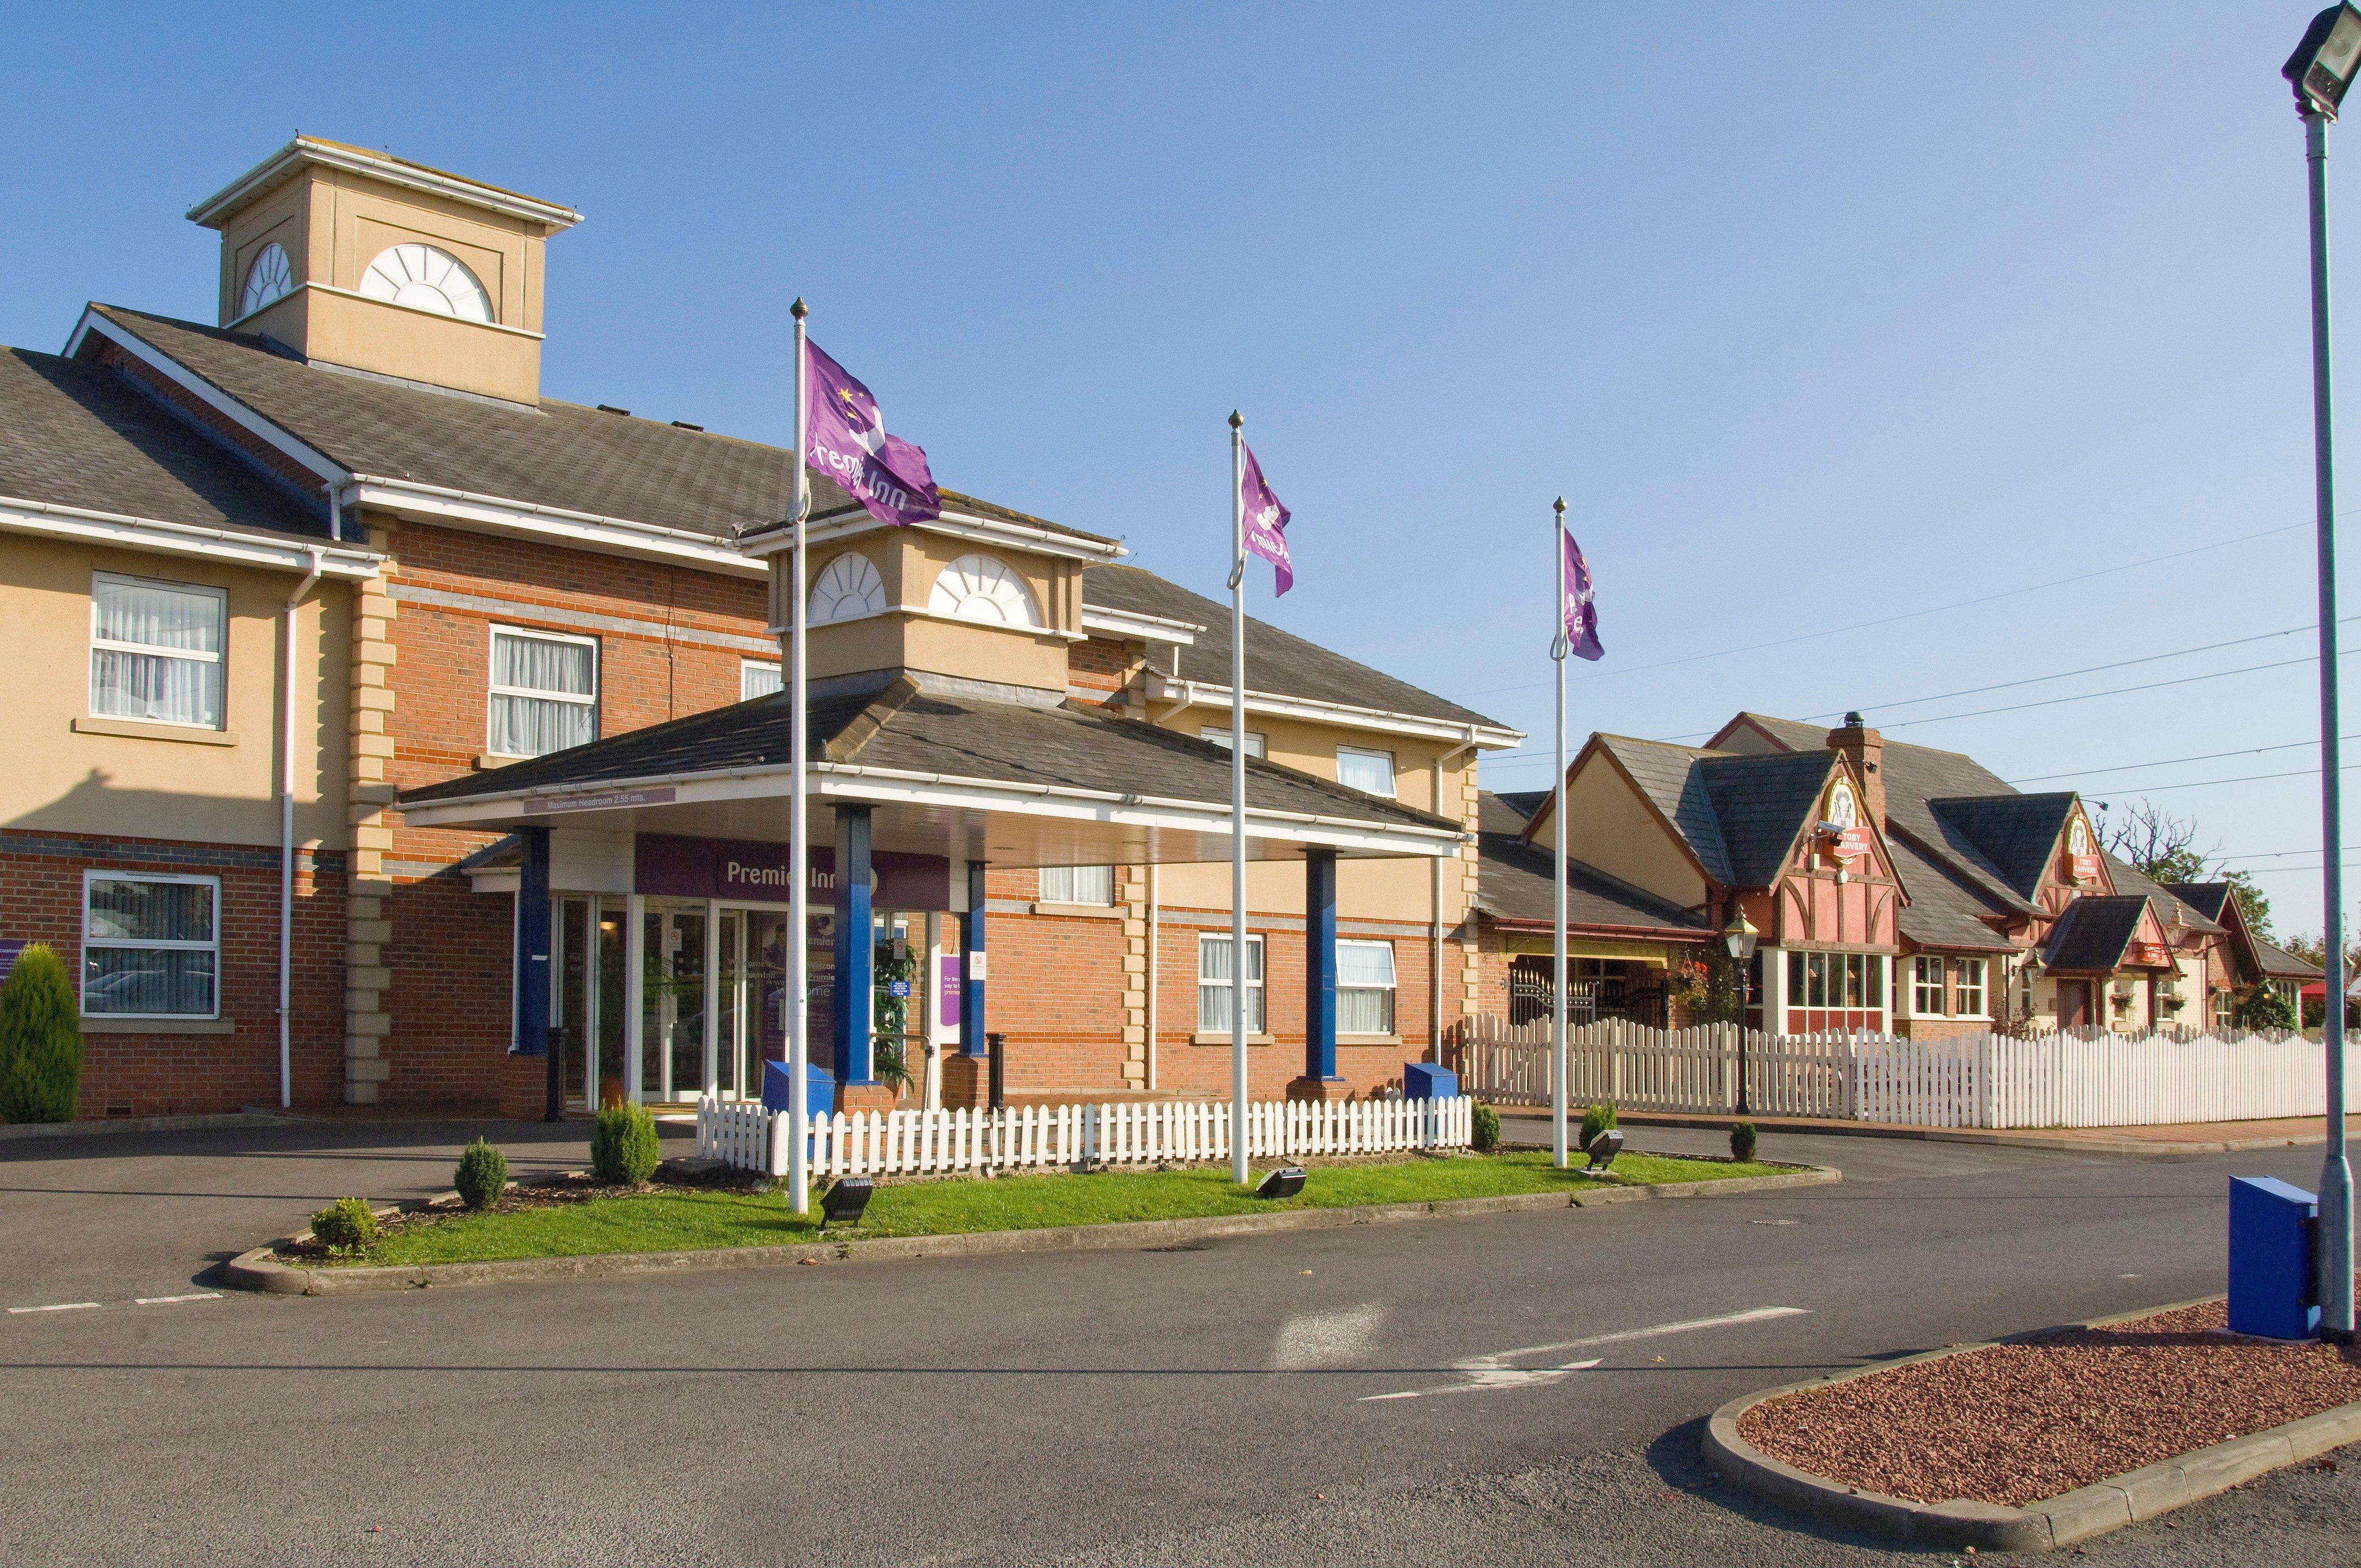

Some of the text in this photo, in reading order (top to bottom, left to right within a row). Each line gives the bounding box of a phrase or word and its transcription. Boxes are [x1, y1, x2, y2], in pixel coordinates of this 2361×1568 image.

[868, 471, 907, 511] Inn
[547, 800, 577, 809] Maximum
[579, 796, 613, 807] Headroom
[614, 794, 629, 803] 2.55
[1842, 832, 1860, 842] TOBY
[728, 861, 791, 885] Premi
